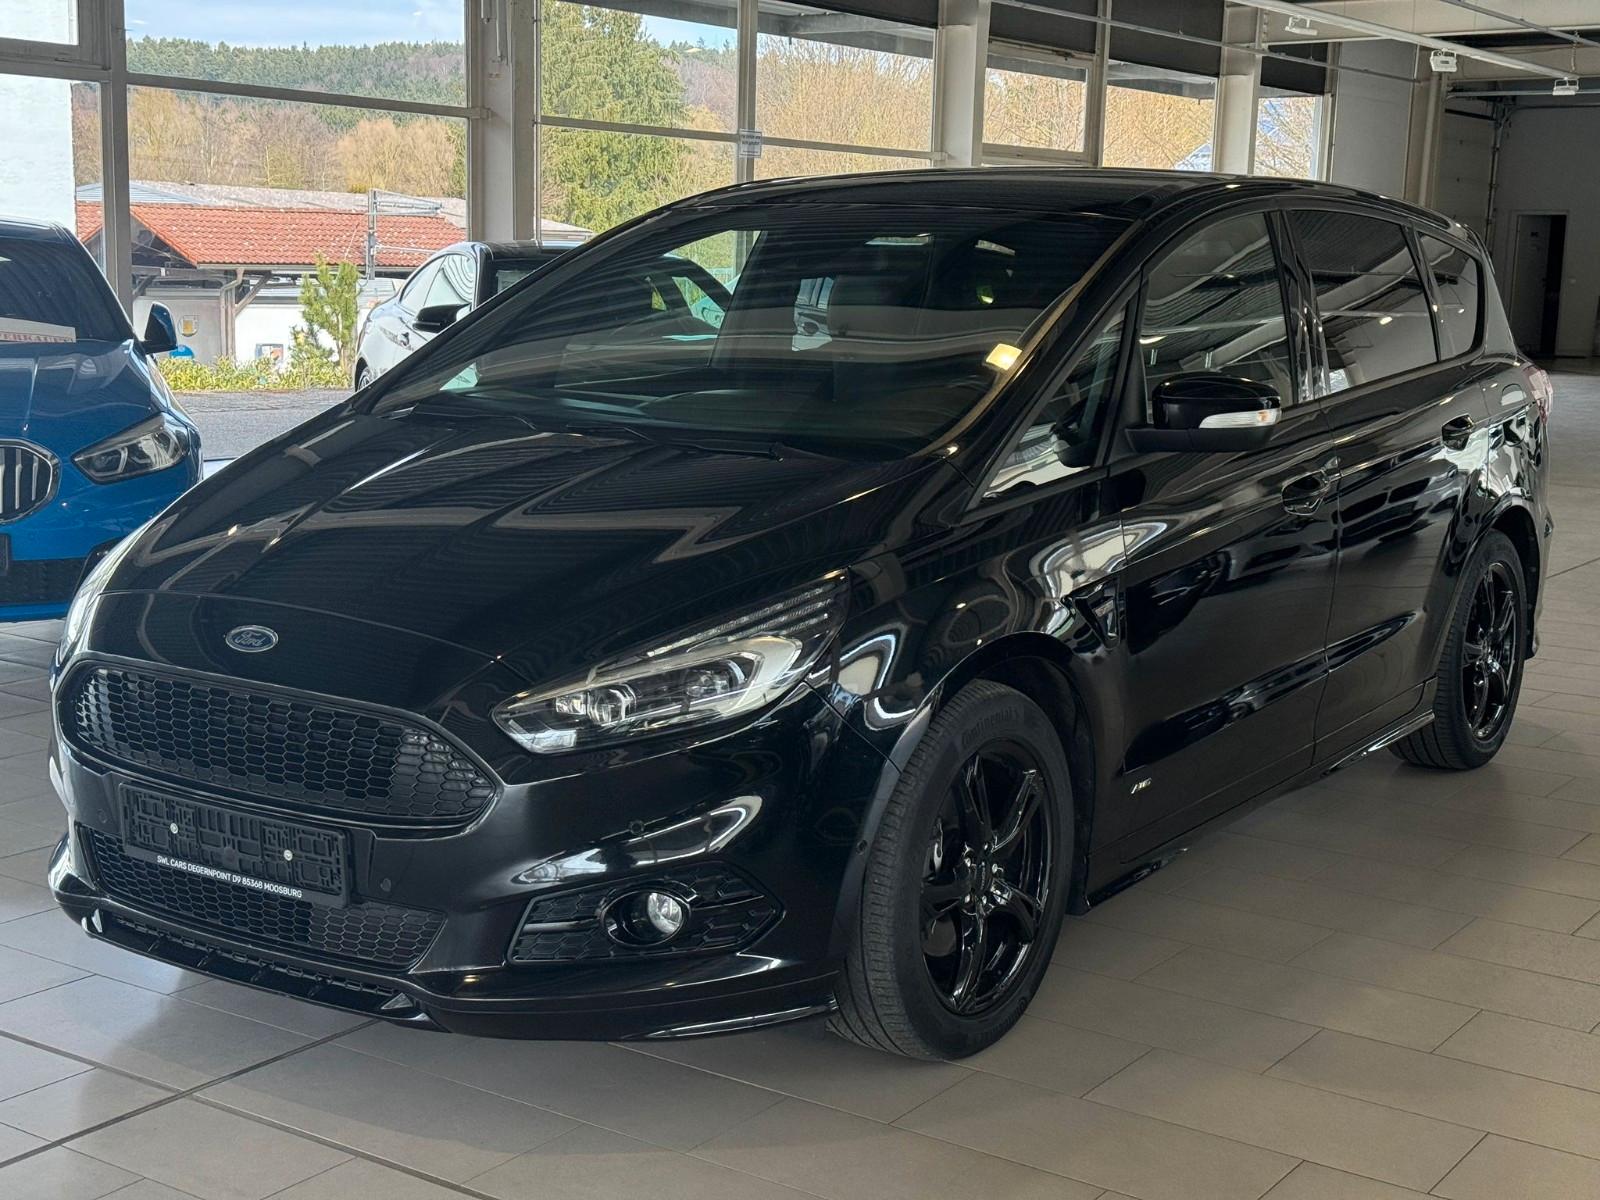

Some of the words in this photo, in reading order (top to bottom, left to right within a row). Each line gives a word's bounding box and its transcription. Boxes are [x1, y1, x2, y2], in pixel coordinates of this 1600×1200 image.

[170, 859, 187, 870] CARS
[187, 863, 232, 882] DEGERNPOINT
[242, 877, 263, 889] 85368
[264, 883, 302, 898] MOOSBURG
